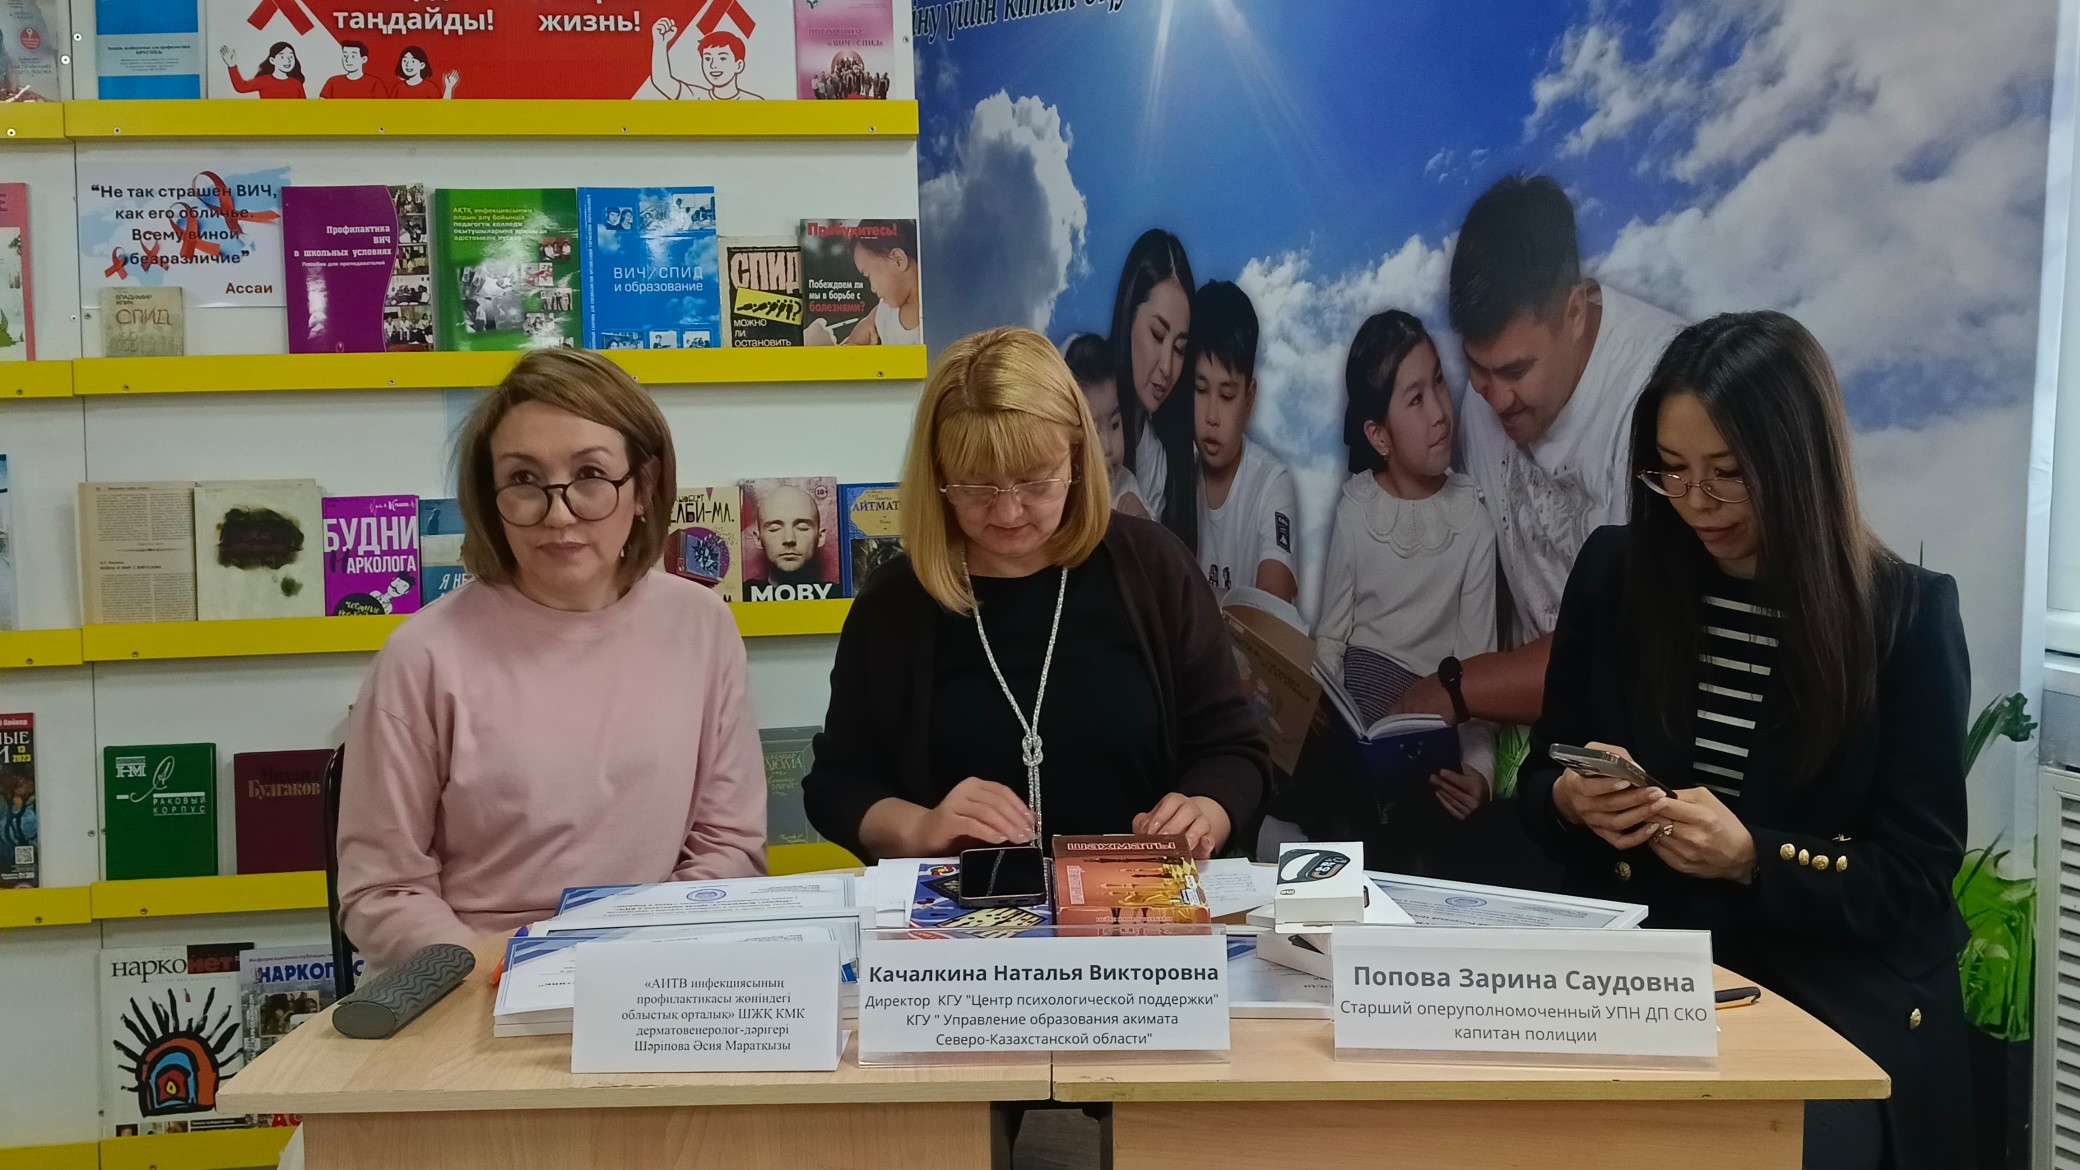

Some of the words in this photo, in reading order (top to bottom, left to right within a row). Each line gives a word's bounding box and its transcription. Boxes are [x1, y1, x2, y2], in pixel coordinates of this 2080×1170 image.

[332, 6, 494, 35] таңдайды!
[538, 10, 641, 32] жизнь!
[127, 187, 154, 198] так
[158, 186, 231, 200] страшен
[237, 184, 277, 199] ВИЧ,
[115, 210, 144, 219] как
[148, 210, 174, 221] его
[179, 207, 254, 219] обличье.
[132, 229, 183, 242] Всему
[188, 228, 240, 240] виной
[326, 225, 391, 235] Профилактика
[808, 222, 898, 238] Пробудитесь!
[373, 236, 391, 244] ВИЧ
[303, 249, 349, 257] школьных
[352, 248, 392, 257] условиях
[730, 251, 803, 294] СПИД
[225, 282, 273, 294] Ассаи
[614, 283, 622, 292] и
[624, 281, 703, 295] образование
[808, 279, 853, 289] Побеждаем
[853, 281, 864, 289] ли
[808, 292, 821, 300] мы
[822, 292, 828, 300] в
[828, 290, 855, 302] борьбе
[856, 292, 861, 300] с
[809, 301, 866, 313] болезнями?
[115, 308, 172, 326] СПИД
[733, 318, 767, 327] можно
[734, 339, 792, 347] остановить
[852, 499, 900, 512] АЙТМАТ
[322, 515, 419, 556] БУДНИ
[438, 573, 451, 590] Я
[750, 582, 833, 602] MOBY
[248, 779, 321, 800] Булгаков
[153, 797, 206, 805] РАКОВЫЙ
[153, 805, 206, 814] КОРПУС
[869, 966, 987, 982] Качалкина
[993, 964, 1083, 981] Наталья
[1089, 964, 1219, 985] Викторовна
[1353, 966, 1451, 988] Попова
[1459, 968, 1557, 994] Зарина
[1565, 970, 1695, 996] Саудовна
[644, 978, 688, 989] «АИТВ
[691, 978, 785, 992] инфекциясының
[637, 993, 732, 1006] профилактикасы
[735, 993, 791, 1006] жөніндегі
[865, 995, 930, 1010] Директор
[938, 995, 962, 1007] КГУ
[966, 994, 1013, 1009] "Центр
[1016, 992, 1135, 1010] психологической
[1138, 994, 1220, 1010] поддержки"
[621, 1009, 679, 1021] облыстық
[681, 1009, 735, 1021] орталық»
[738, 1008, 773, 1021] ШЖҚ
[775, 1008, 805, 1020] КМК
[1340, 1000, 1412, 1018] Старший
[1417, 1001, 1602, 1020] оперуполномоченный
[1605, 1005, 1640, 1020] УПН
[1645, 1006, 1669, 1023] ДП
[1674, 1008, 1708, 1022] СКО
[906, 1013, 930, 1027] КГУ
[943, 1013, 1026, 1029] Управление
[1029, 1011, 1119, 1029] образования
[1122, 1014, 1179, 1025] акимата
[636, 1024, 790, 1038] дерматовенеролог-дәрігері
[1454, 1027, 1520, 1041] капитан
[1525, 1028, 1598, 1043] полиции
[634, 1040, 690, 1054] Шәріпова
[693, 1039, 722, 1052] Әсия
[725, 1039, 791, 1053] Маратқызы
[936, 1031, 1090, 1048] Северо-Казахстанской
[1092, 1032, 1153, 1045] области"
